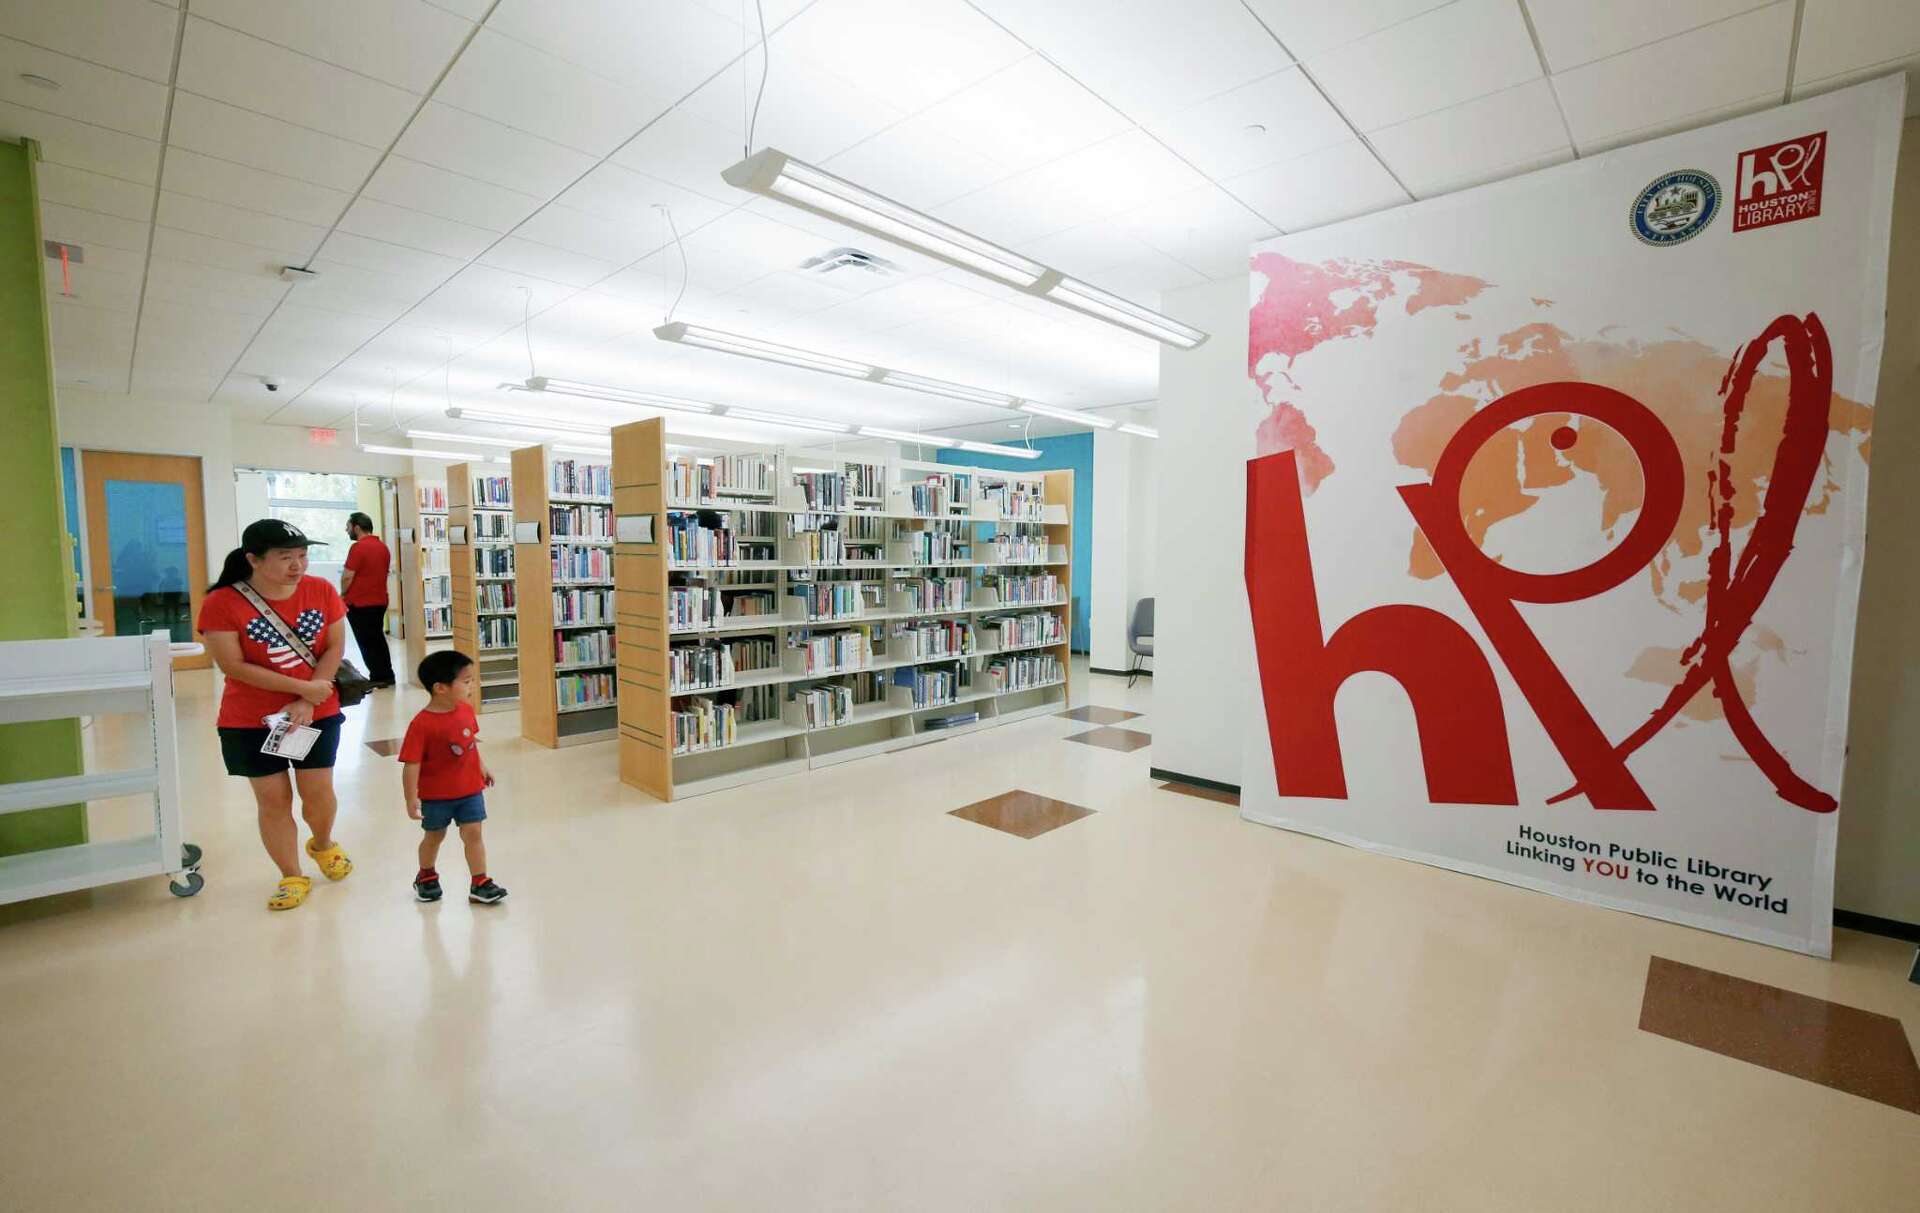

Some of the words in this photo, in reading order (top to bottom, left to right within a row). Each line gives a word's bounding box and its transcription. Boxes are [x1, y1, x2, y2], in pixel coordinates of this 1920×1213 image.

[1738, 201, 1808, 228] LIBRARY
[1739, 191, 1809, 213] HOUSTON
[1506, 840, 1575, 871] Linking
[1583, 857, 1629, 880] YOU
[1636, 868, 1658, 886] to
[1666, 873, 1705, 895] the
[1714, 883, 1788, 914] World
[1519, 825, 1601, 855] Houston
[1609, 843, 1678, 869] Public
[1687, 857, 1772, 891] Library
